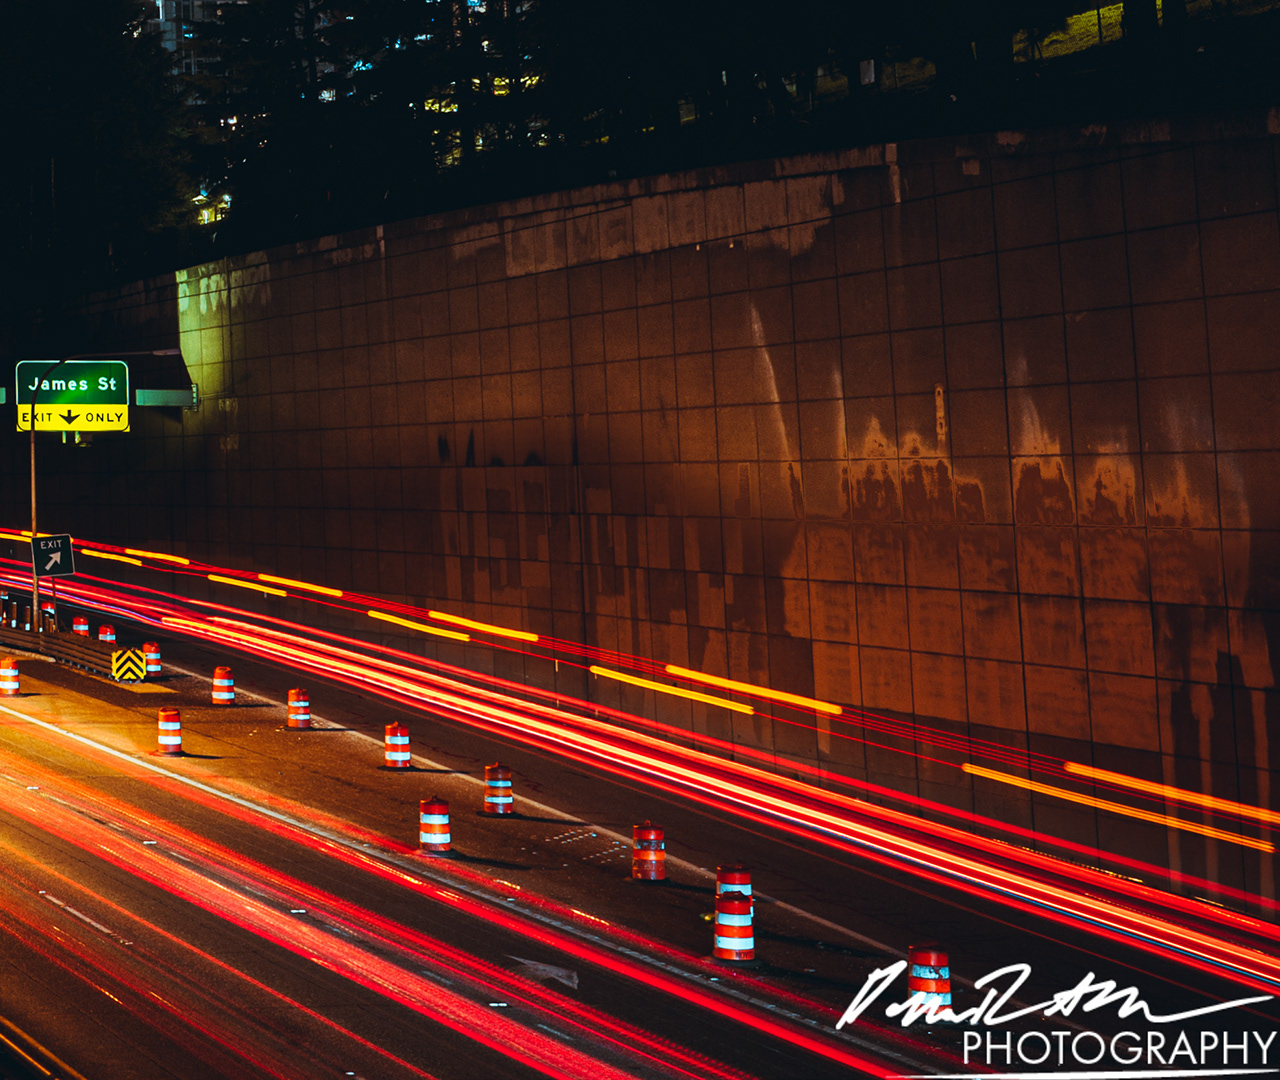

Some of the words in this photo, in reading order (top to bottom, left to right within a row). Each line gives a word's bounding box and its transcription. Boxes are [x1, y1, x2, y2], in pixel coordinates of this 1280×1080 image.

[28, 377, 88, 391] James
[98, 377, 117, 391] St
[22, 413, 52, 422] EXIT
[86, 412, 124, 423] ONLY
[40, 540, 62, 549] EXIT
